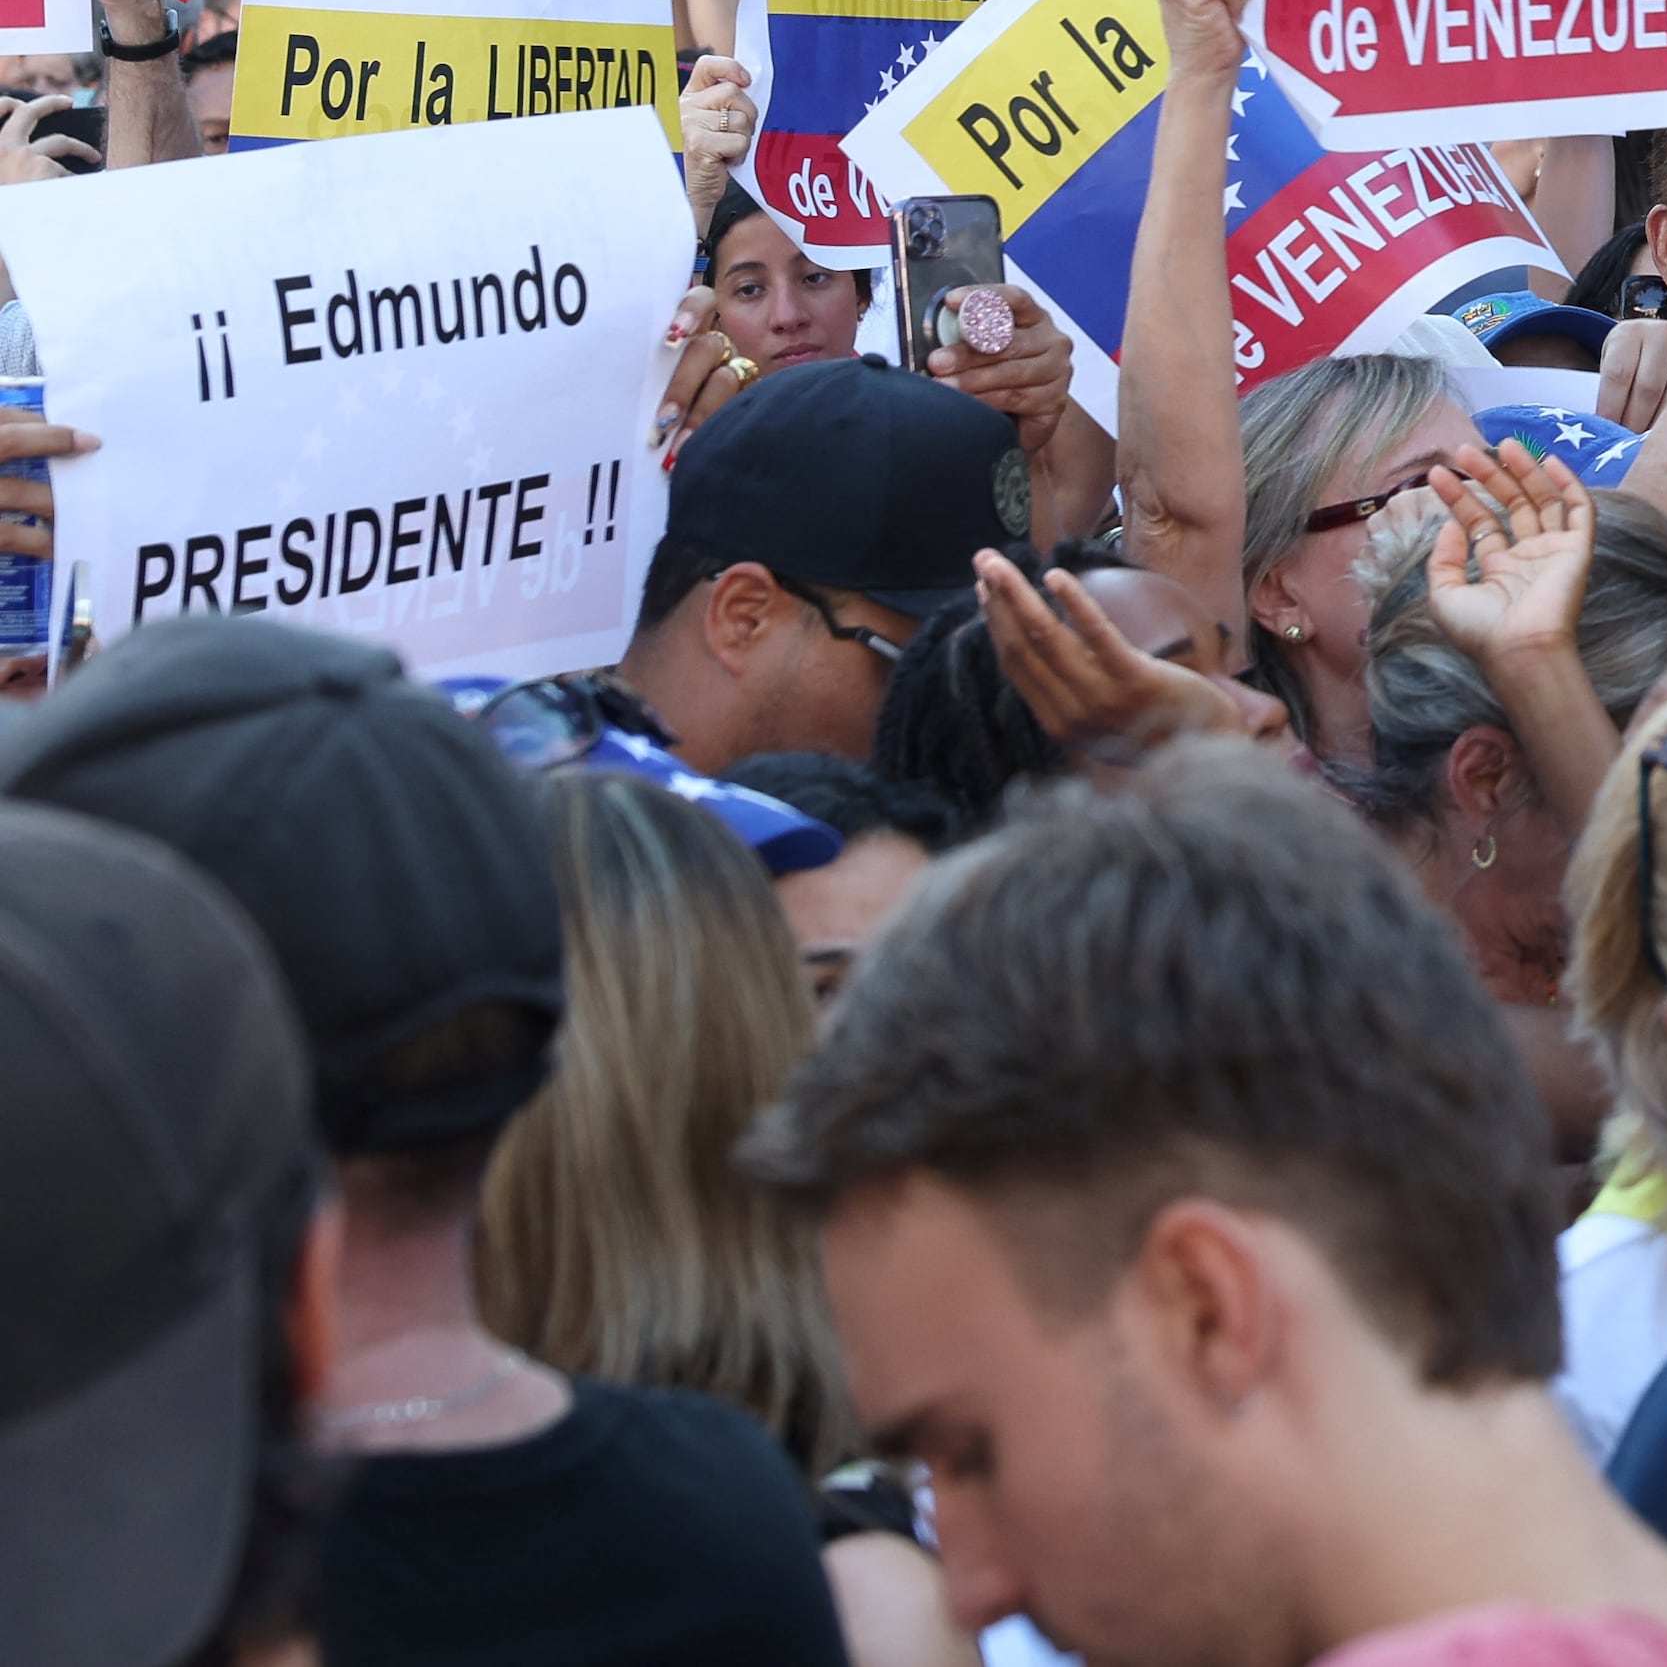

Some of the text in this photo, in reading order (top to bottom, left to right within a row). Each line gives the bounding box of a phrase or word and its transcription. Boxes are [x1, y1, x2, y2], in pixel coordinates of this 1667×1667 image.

[281, 34, 656, 125] Por la LIBERTAD
[957, 70, 1080, 190] Por
[1060, 16, 1156, 93] la
[788, 158, 837, 219] de
[1231, 145, 1514, 327] VENEZUELA
[274, 244, 588, 365] Edmundo
[132, 472, 551, 629] PRESIDENTE
[583, 459, 622, 546] !!
